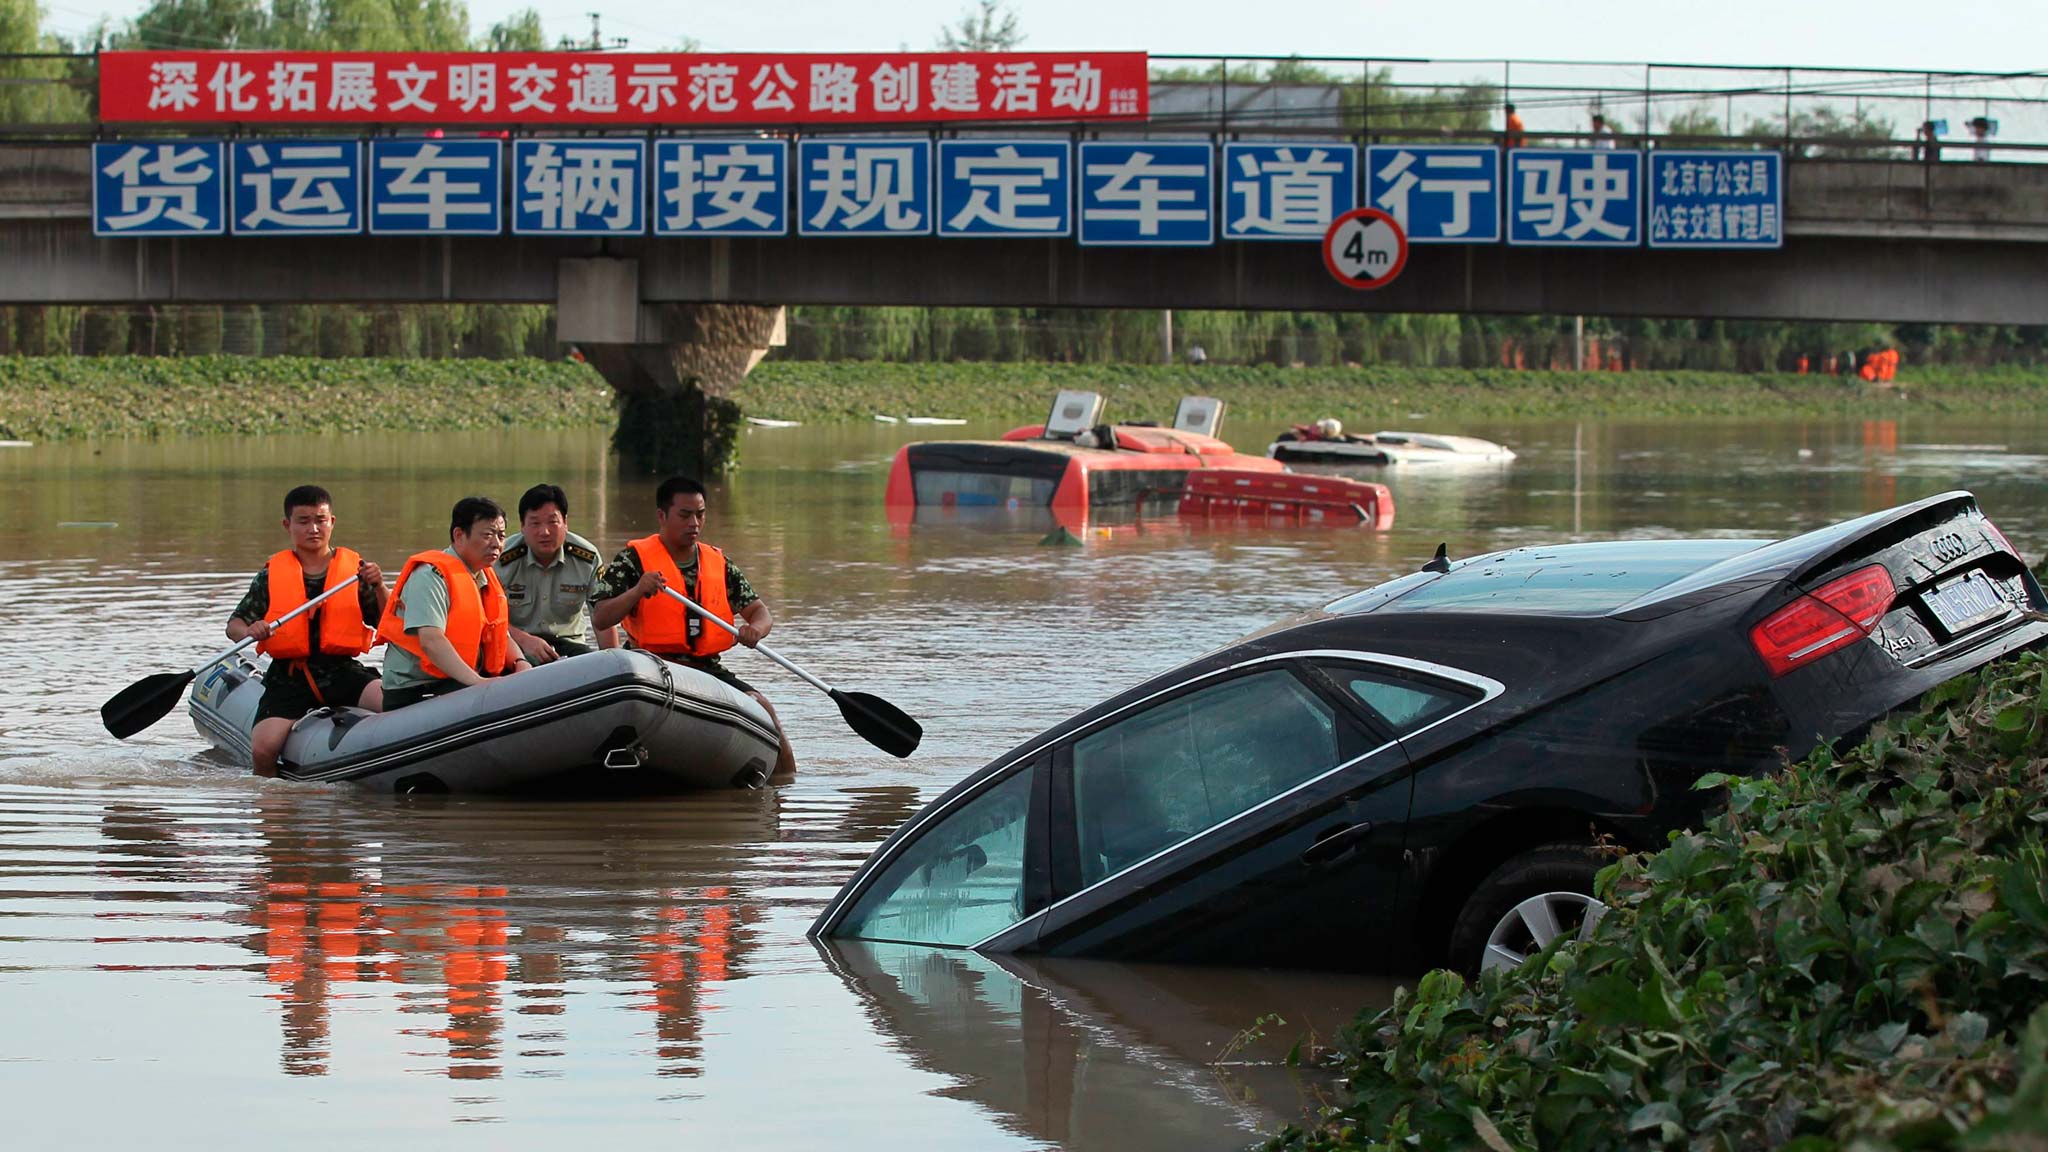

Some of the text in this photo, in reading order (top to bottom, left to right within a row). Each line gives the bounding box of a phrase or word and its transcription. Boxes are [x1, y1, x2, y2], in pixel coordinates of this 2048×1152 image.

[148, 59, 1102, 114] 深化拓展文明交通示范公路创建活动
[102, 145, 1630, 241] 货运车辆按规定车道行驶
[1661, 159, 1769, 196] 北京市公安局
[1653, 203, 1777, 240] 公安交通管理局
[1343, 230, 1388, 264] 4m
